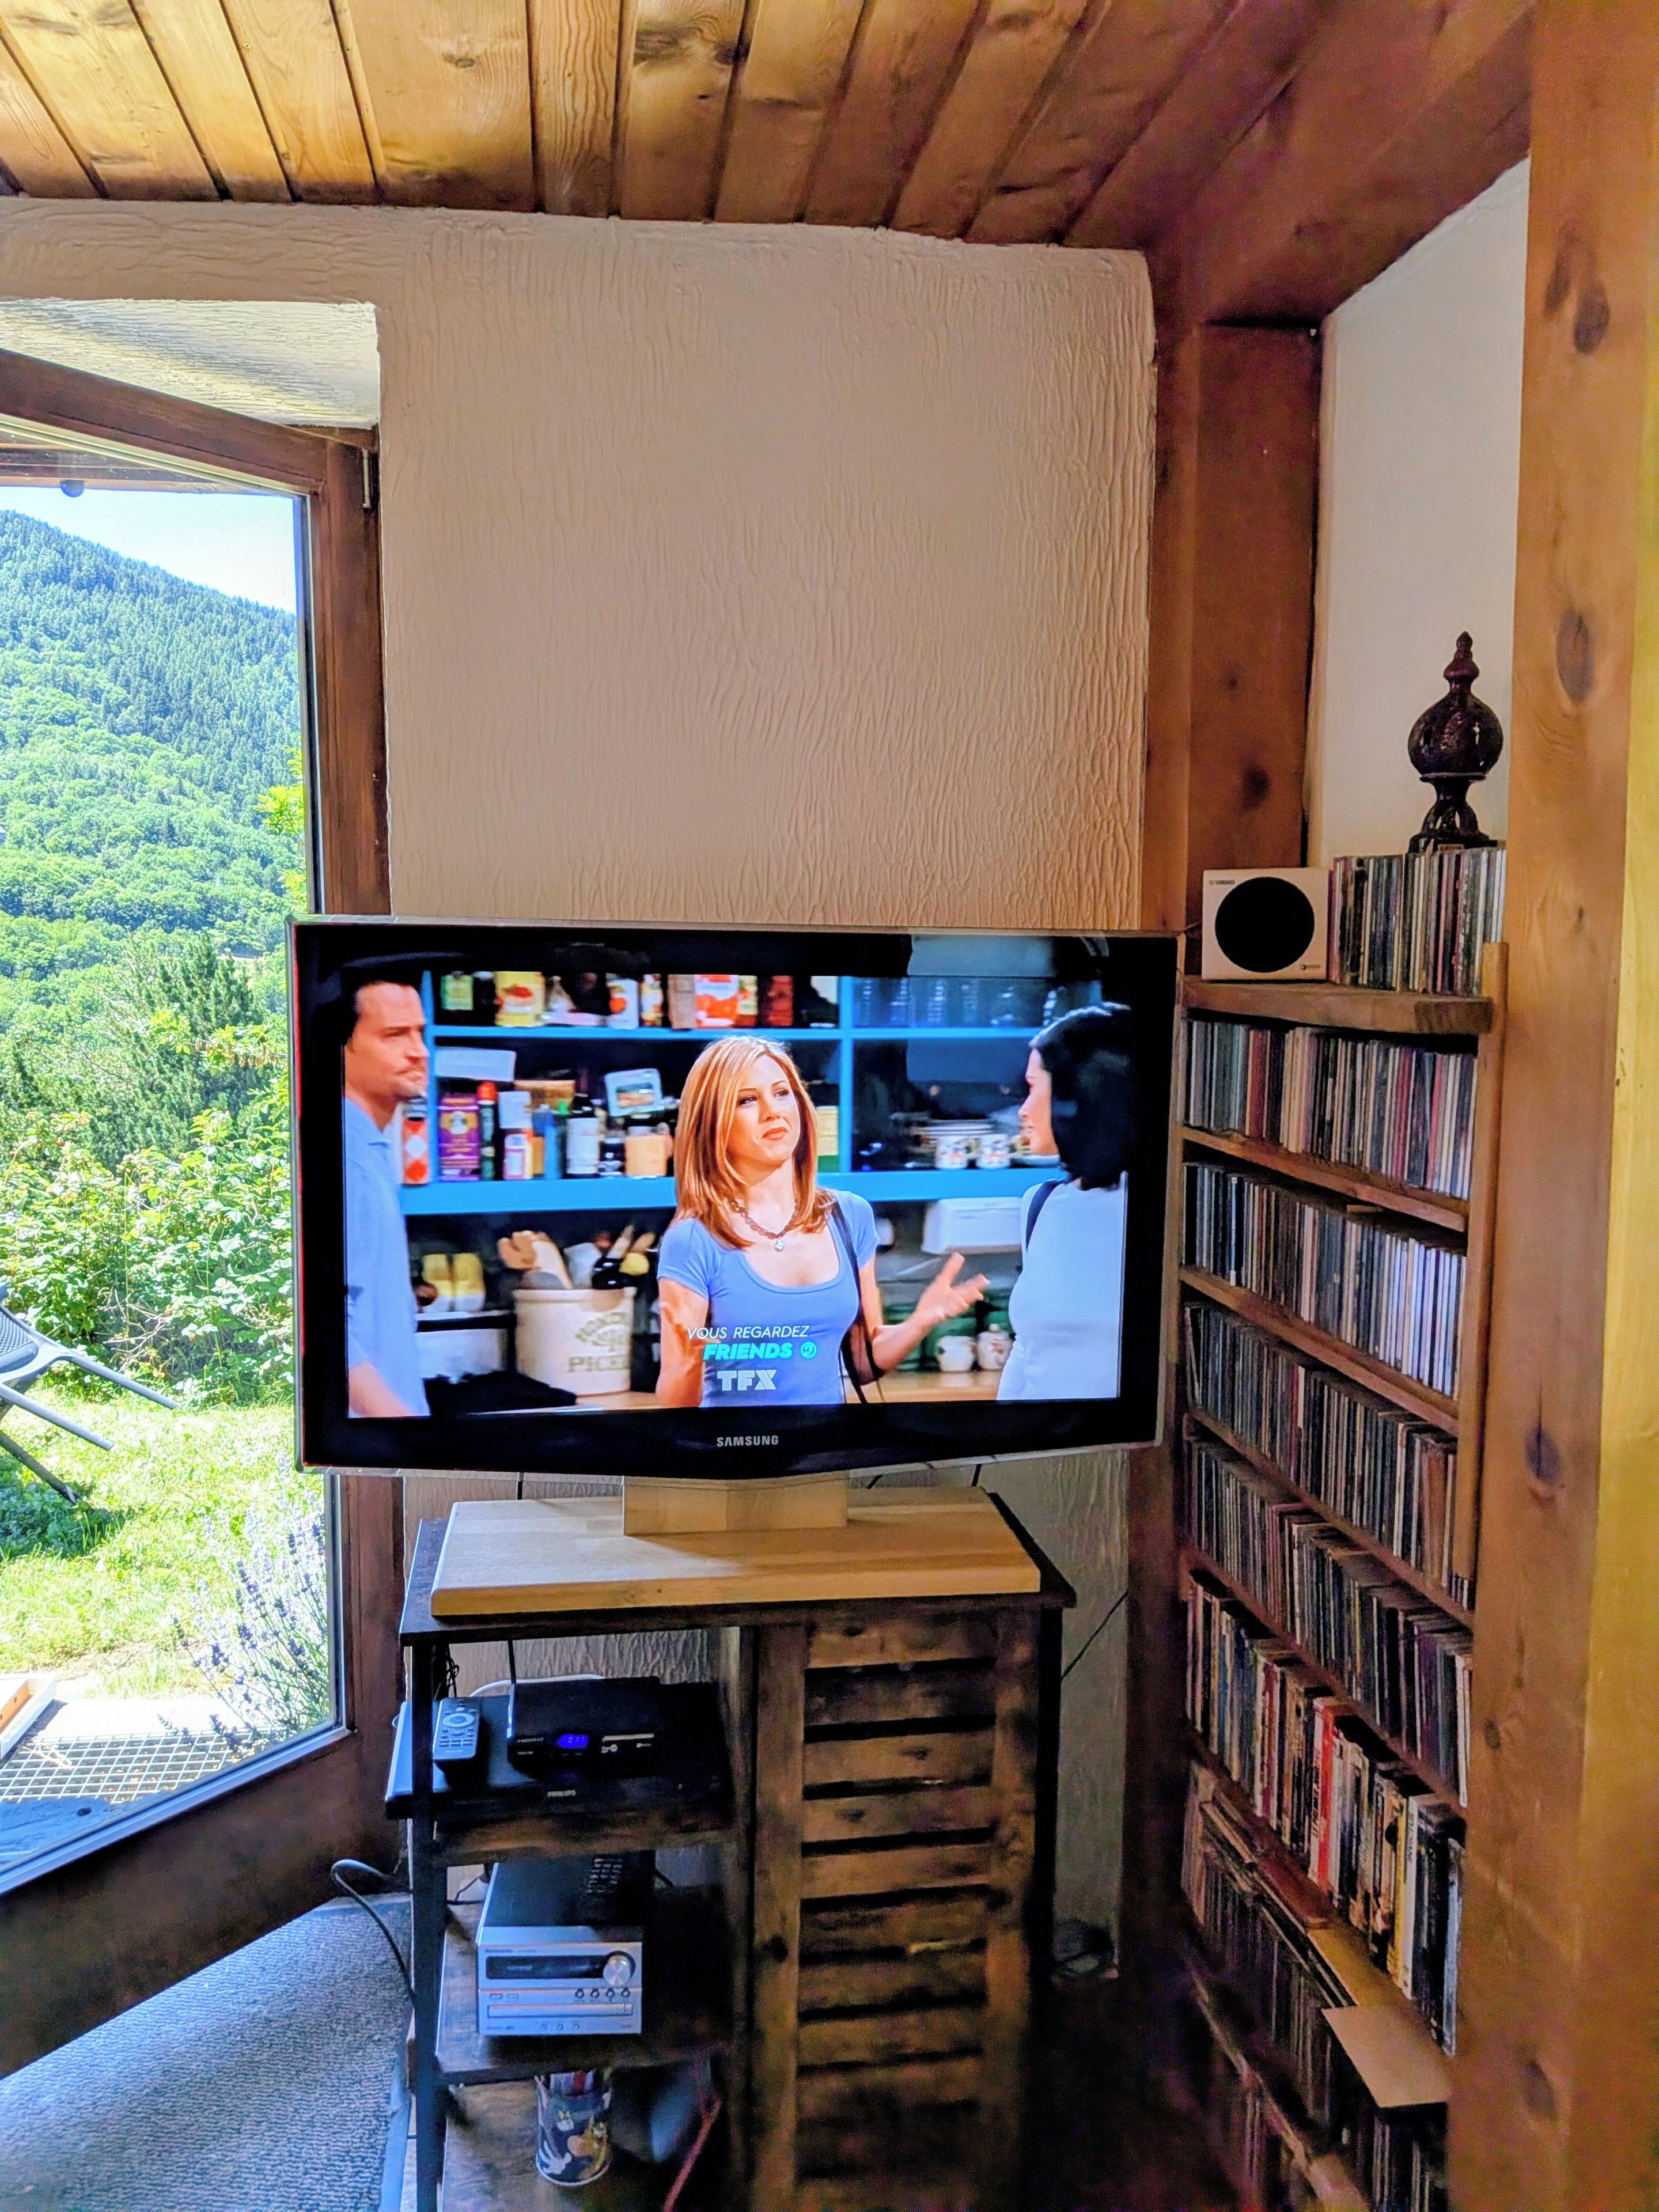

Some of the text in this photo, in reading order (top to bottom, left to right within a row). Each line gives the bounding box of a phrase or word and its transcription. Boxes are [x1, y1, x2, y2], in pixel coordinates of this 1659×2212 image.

[687, 1325, 810, 1340] VOUS REGARDEZ
[702, 1342, 793, 1361] FRIENDS
[717, 1369, 777, 1392] TFX
[716, 1435, 779, 1447] SAMSUNG
